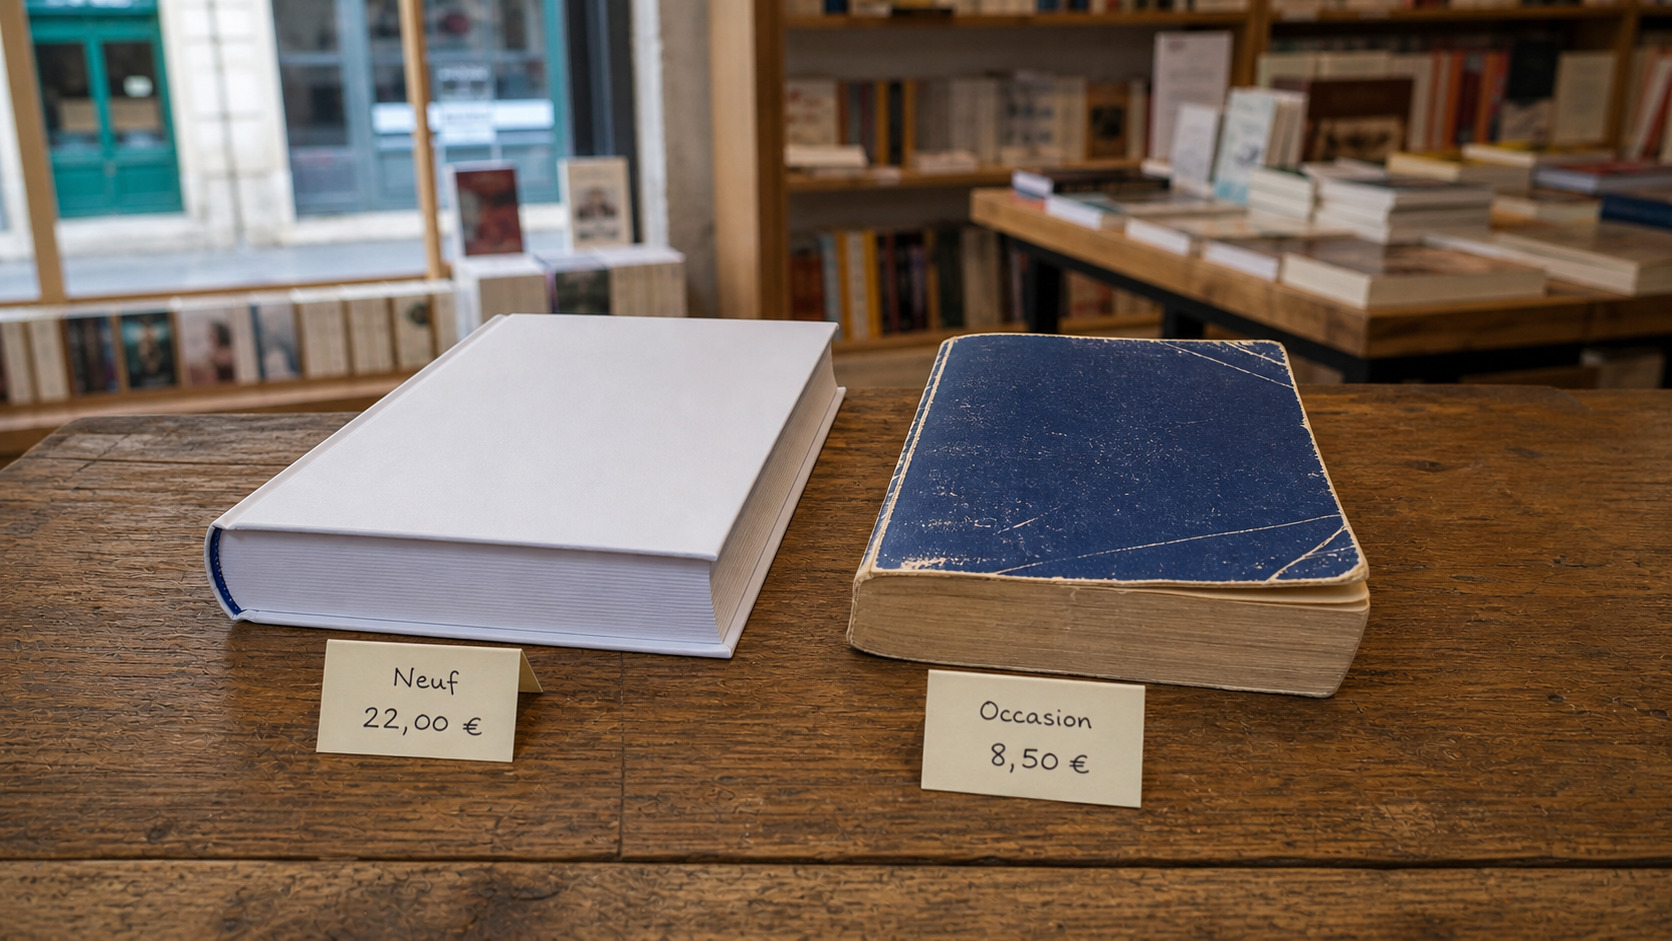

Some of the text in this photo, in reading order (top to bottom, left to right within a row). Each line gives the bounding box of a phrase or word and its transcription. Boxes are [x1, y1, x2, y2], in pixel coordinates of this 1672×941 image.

[393, 667, 460, 696] Neuf
[362, 706, 483, 737] 22,00 €
[979, 700, 1093, 730] Occasion
[990, 742, 1090, 775] 8,50 €
